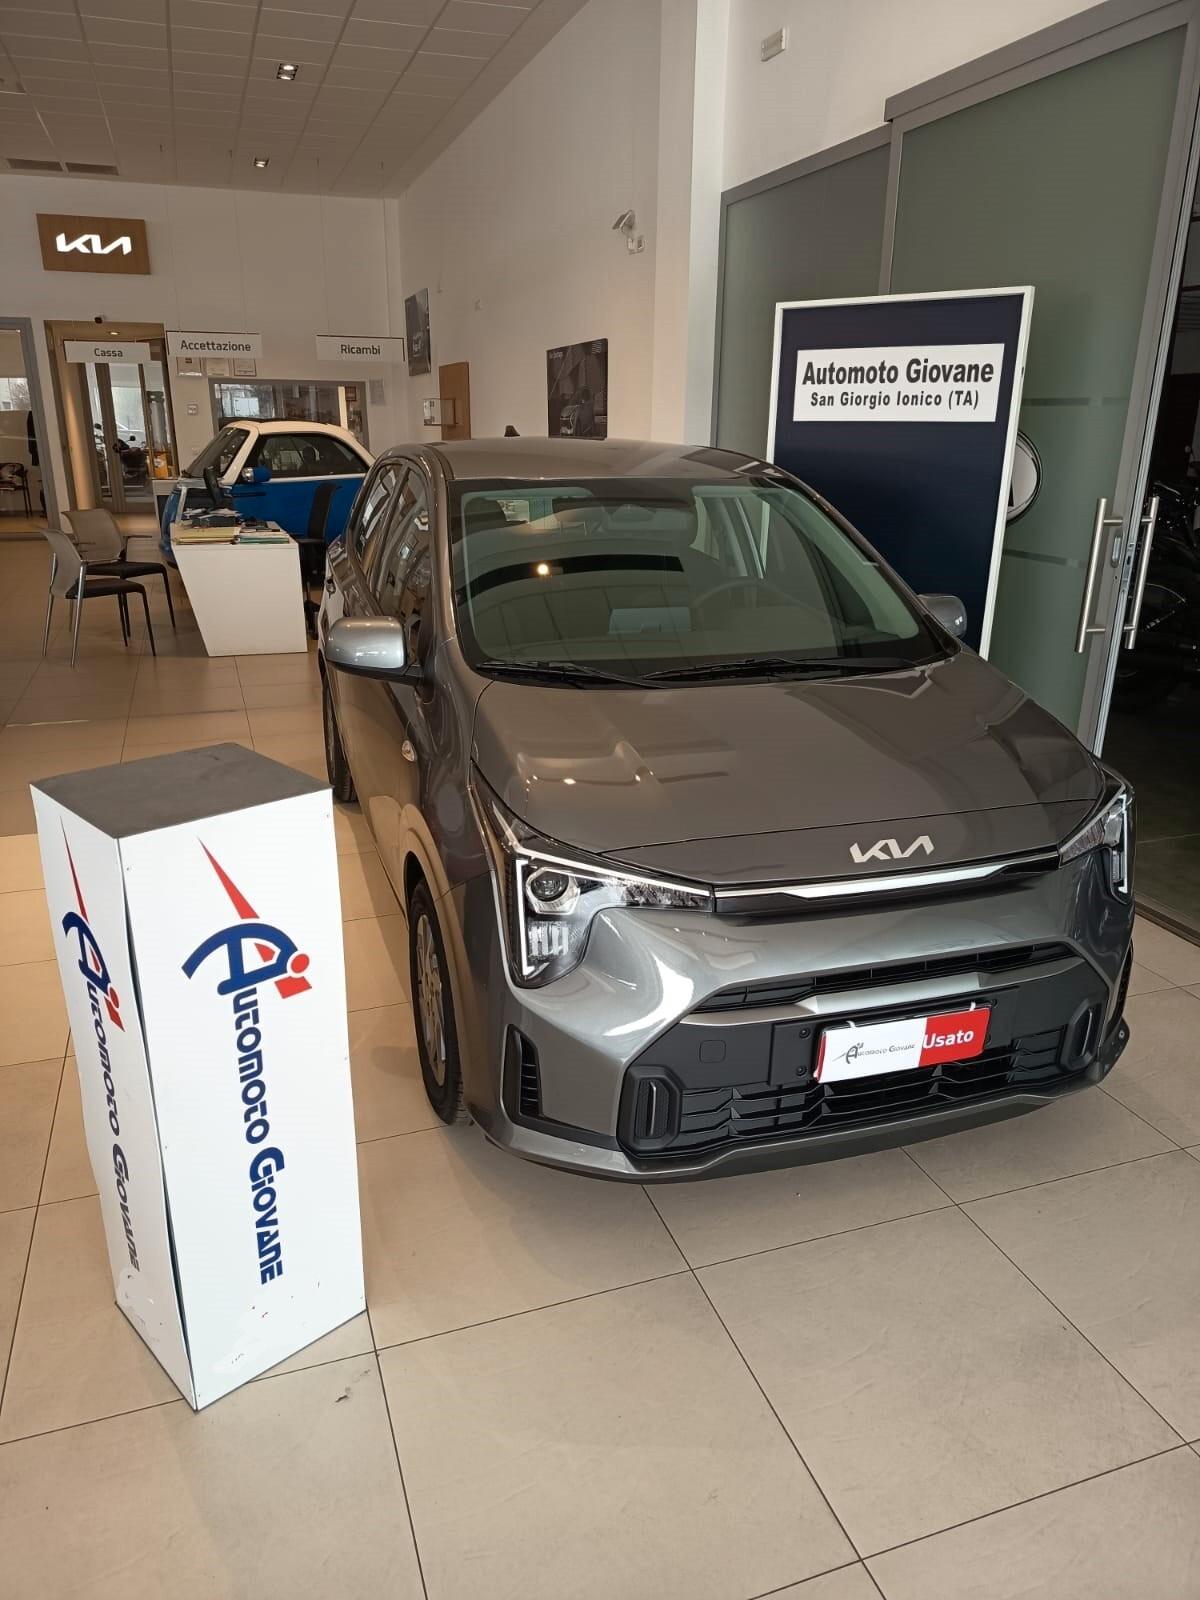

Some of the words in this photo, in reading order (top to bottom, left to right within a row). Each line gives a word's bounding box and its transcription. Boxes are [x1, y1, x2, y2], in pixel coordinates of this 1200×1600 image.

[56, 233, 132, 255] KIA
[94, 347, 124, 358] Cassa
[180, 339, 251, 352] Accettazione
[340, 343, 381, 355] Ricambi
[802, 360, 899, 385] Automoto
[906, 358, 995, 383] Giovane
[811, 391, 834, 406] San
[840, 391, 891, 409] Giorgio
[897, 390, 942, 406] Ionico
[948, 390, 979, 410] (TA)
[849, 835, 935, 863] KIA
[923, 1029, 974, 1049] Usato
